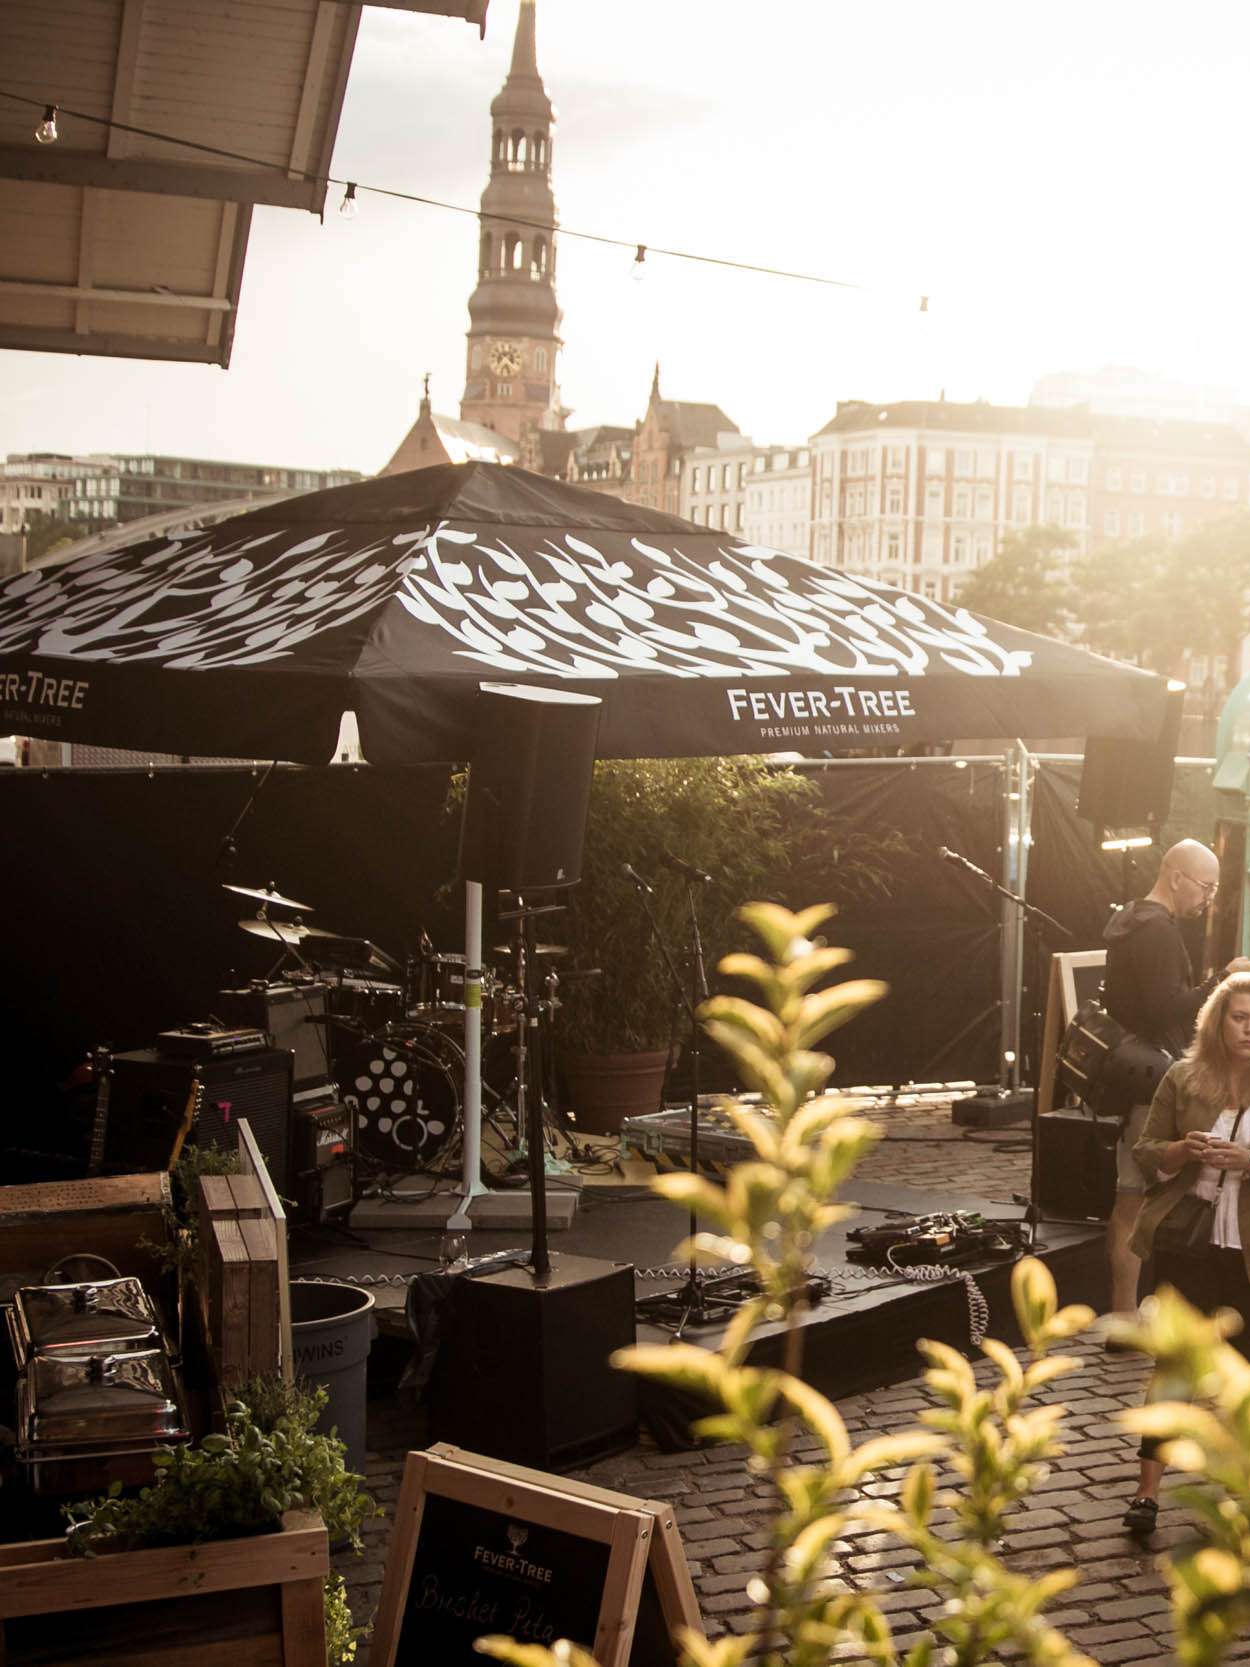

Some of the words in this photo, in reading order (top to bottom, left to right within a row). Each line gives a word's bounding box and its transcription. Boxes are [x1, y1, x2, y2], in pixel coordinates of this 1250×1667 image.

[0, 670, 89, 709] R-TREE
[726, 686, 916, 721] FEVER-TREE
[760, 725, 810, 738] PREMIUM
[814, 723, 860, 736] NATURAL
[862, 722, 900, 735] MIXERS
[473, 1545, 553, 1584] FEVER-TREE
